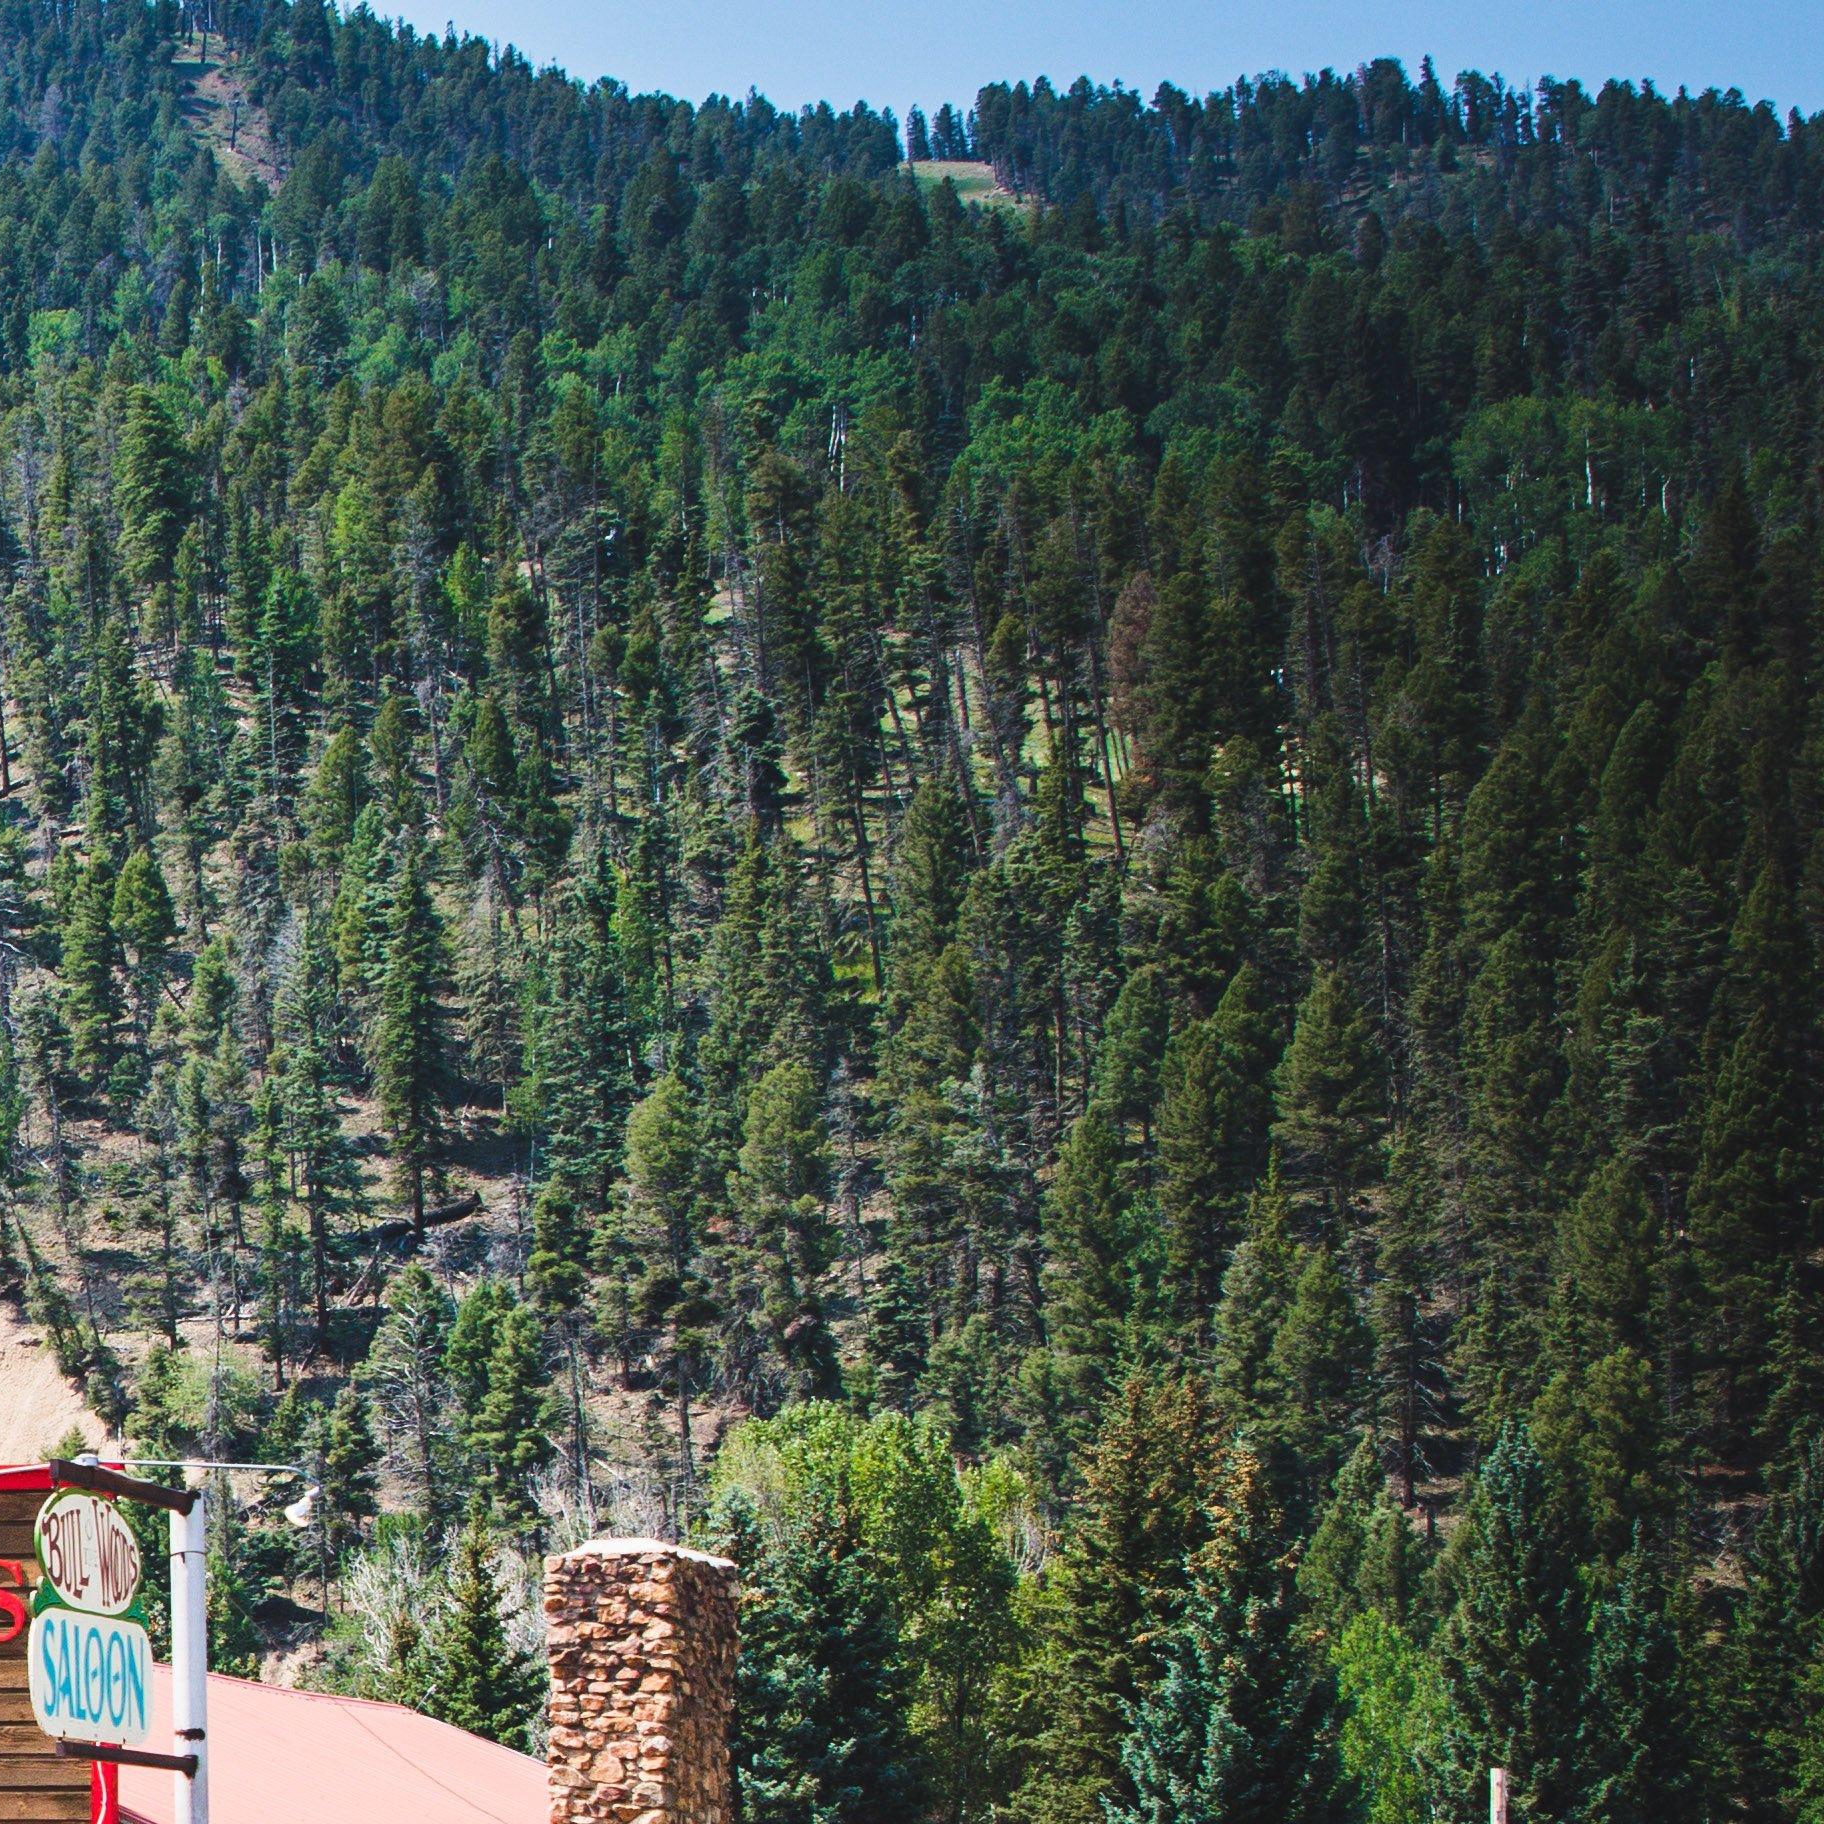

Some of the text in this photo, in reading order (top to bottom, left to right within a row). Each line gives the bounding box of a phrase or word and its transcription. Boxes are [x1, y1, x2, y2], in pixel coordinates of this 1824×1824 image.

[41, 1509, 90, 1599] BULL
[92, 1499, 138, 1608] WOODS
[42, 1618, 145, 1730] SALOON
